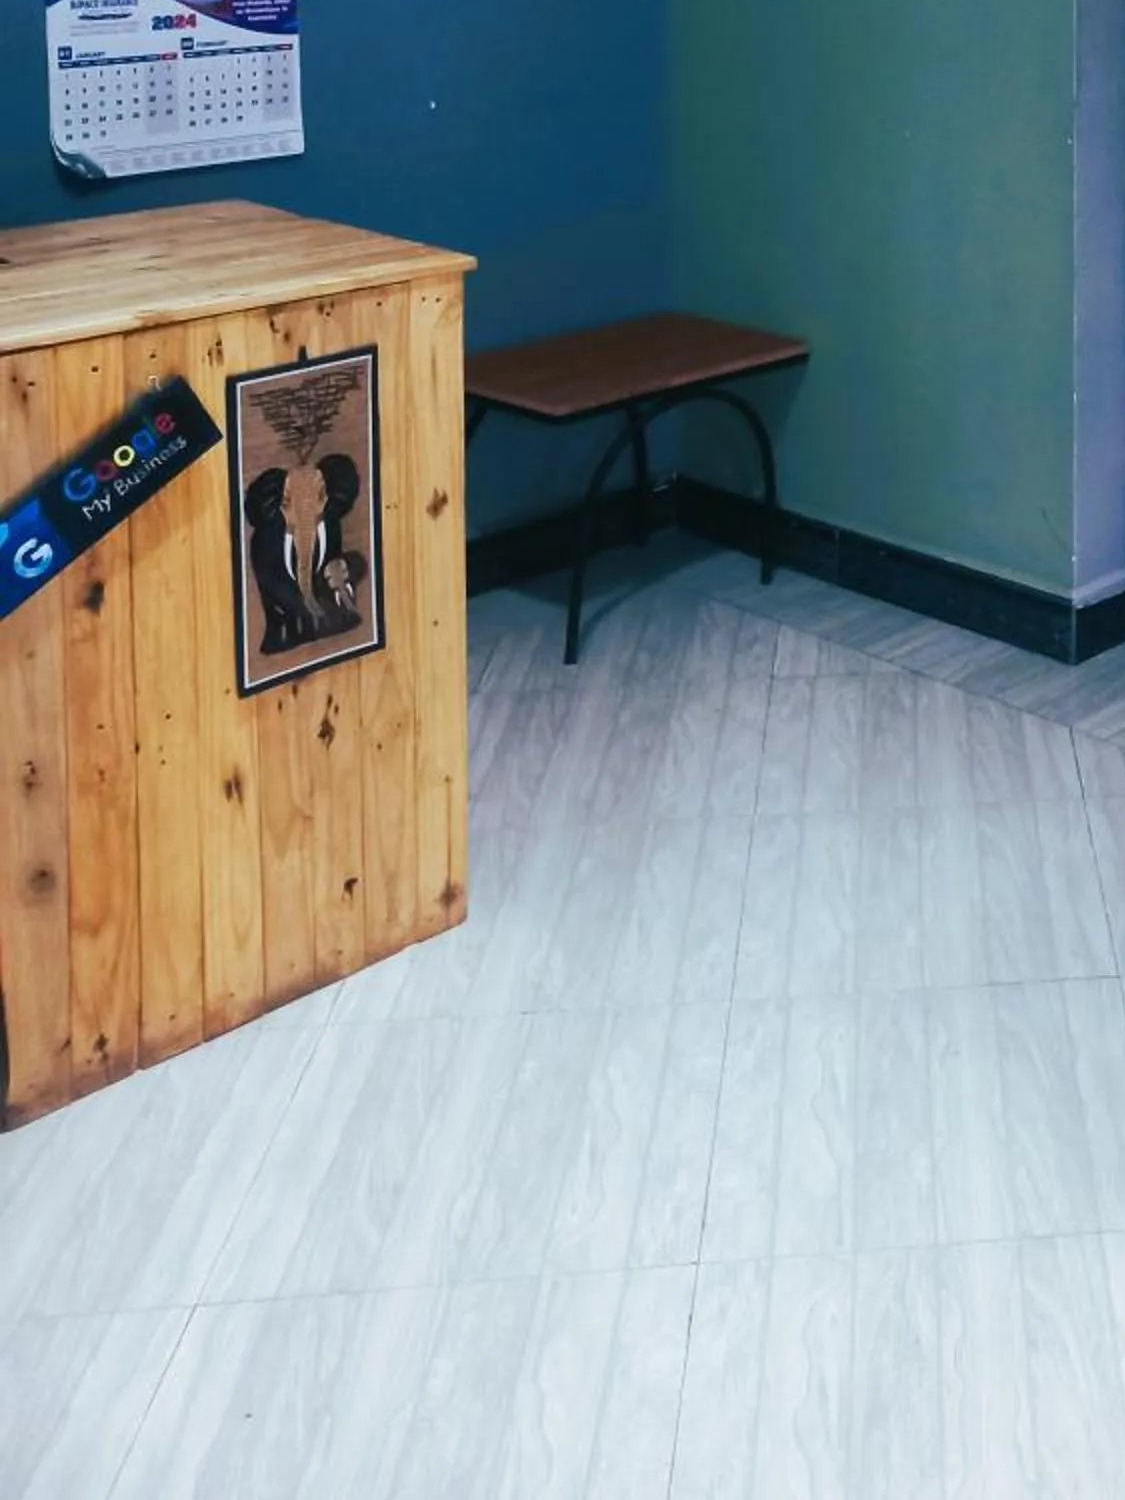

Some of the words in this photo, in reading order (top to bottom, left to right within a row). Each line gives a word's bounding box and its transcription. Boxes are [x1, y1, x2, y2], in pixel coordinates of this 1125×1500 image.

[151, 13, 197, 31] 2024
[64, 412, 176, 501] Google
[82, 490, 112, 521] My
[113, 435, 187, 496] Business
